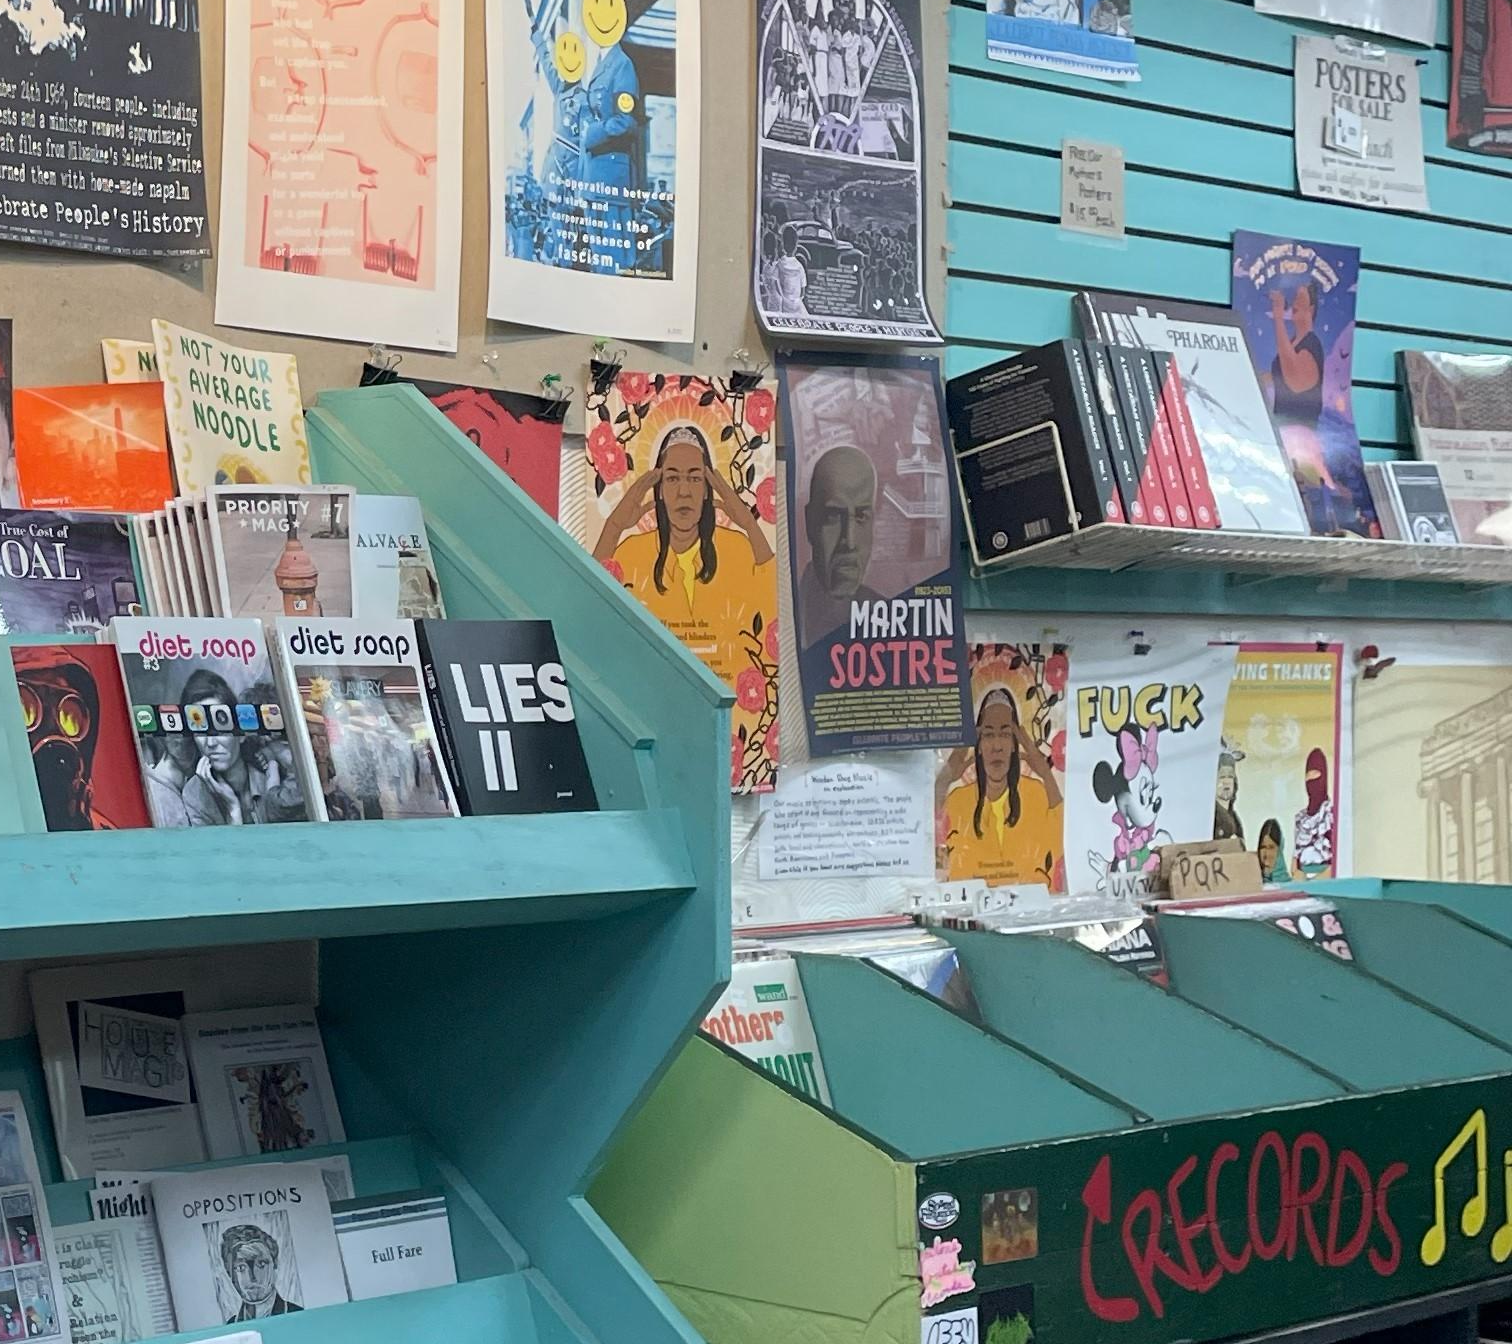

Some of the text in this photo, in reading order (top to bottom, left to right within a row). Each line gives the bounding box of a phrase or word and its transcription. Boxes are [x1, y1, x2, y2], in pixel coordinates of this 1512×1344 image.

[1315, 58, 1406, 103] POSTERS
[548, 171, 673, 201] Co-operation between
[56, 203, 128, 230] People's
[133, 211, 205, 237] History
[1168, 330, 1239, 353] PHAROAH
[180, 337, 270, 383] NOT YOUR
[190, 374, 273, 411] AVERAGE
[194, 401, 281, 452] NOODLE
[225, 499, 310, 516] PRIORITY
[320, 502, 344, 525] #7
[252, 518, 290, 533] MAG
[850, 598, 954, 640] MARTIN
[139, 631, 256, 664] diet soap
[290, 628, 410, 662] diet soap
[830, 641, 958, 688] SOSTRE
[451, 662, 572, 723] LIES
[1077, 683, 1204, 738] FUCK
[479, 731, 518, 791] II
[1179, 857, 1229, 888] PQR
[183, 1188, 302, 1218] OPPOSITIONS
[1123, 1130, 1408, 1318] RECORDS
[372, 1243, 423, 1263] Full Fare
